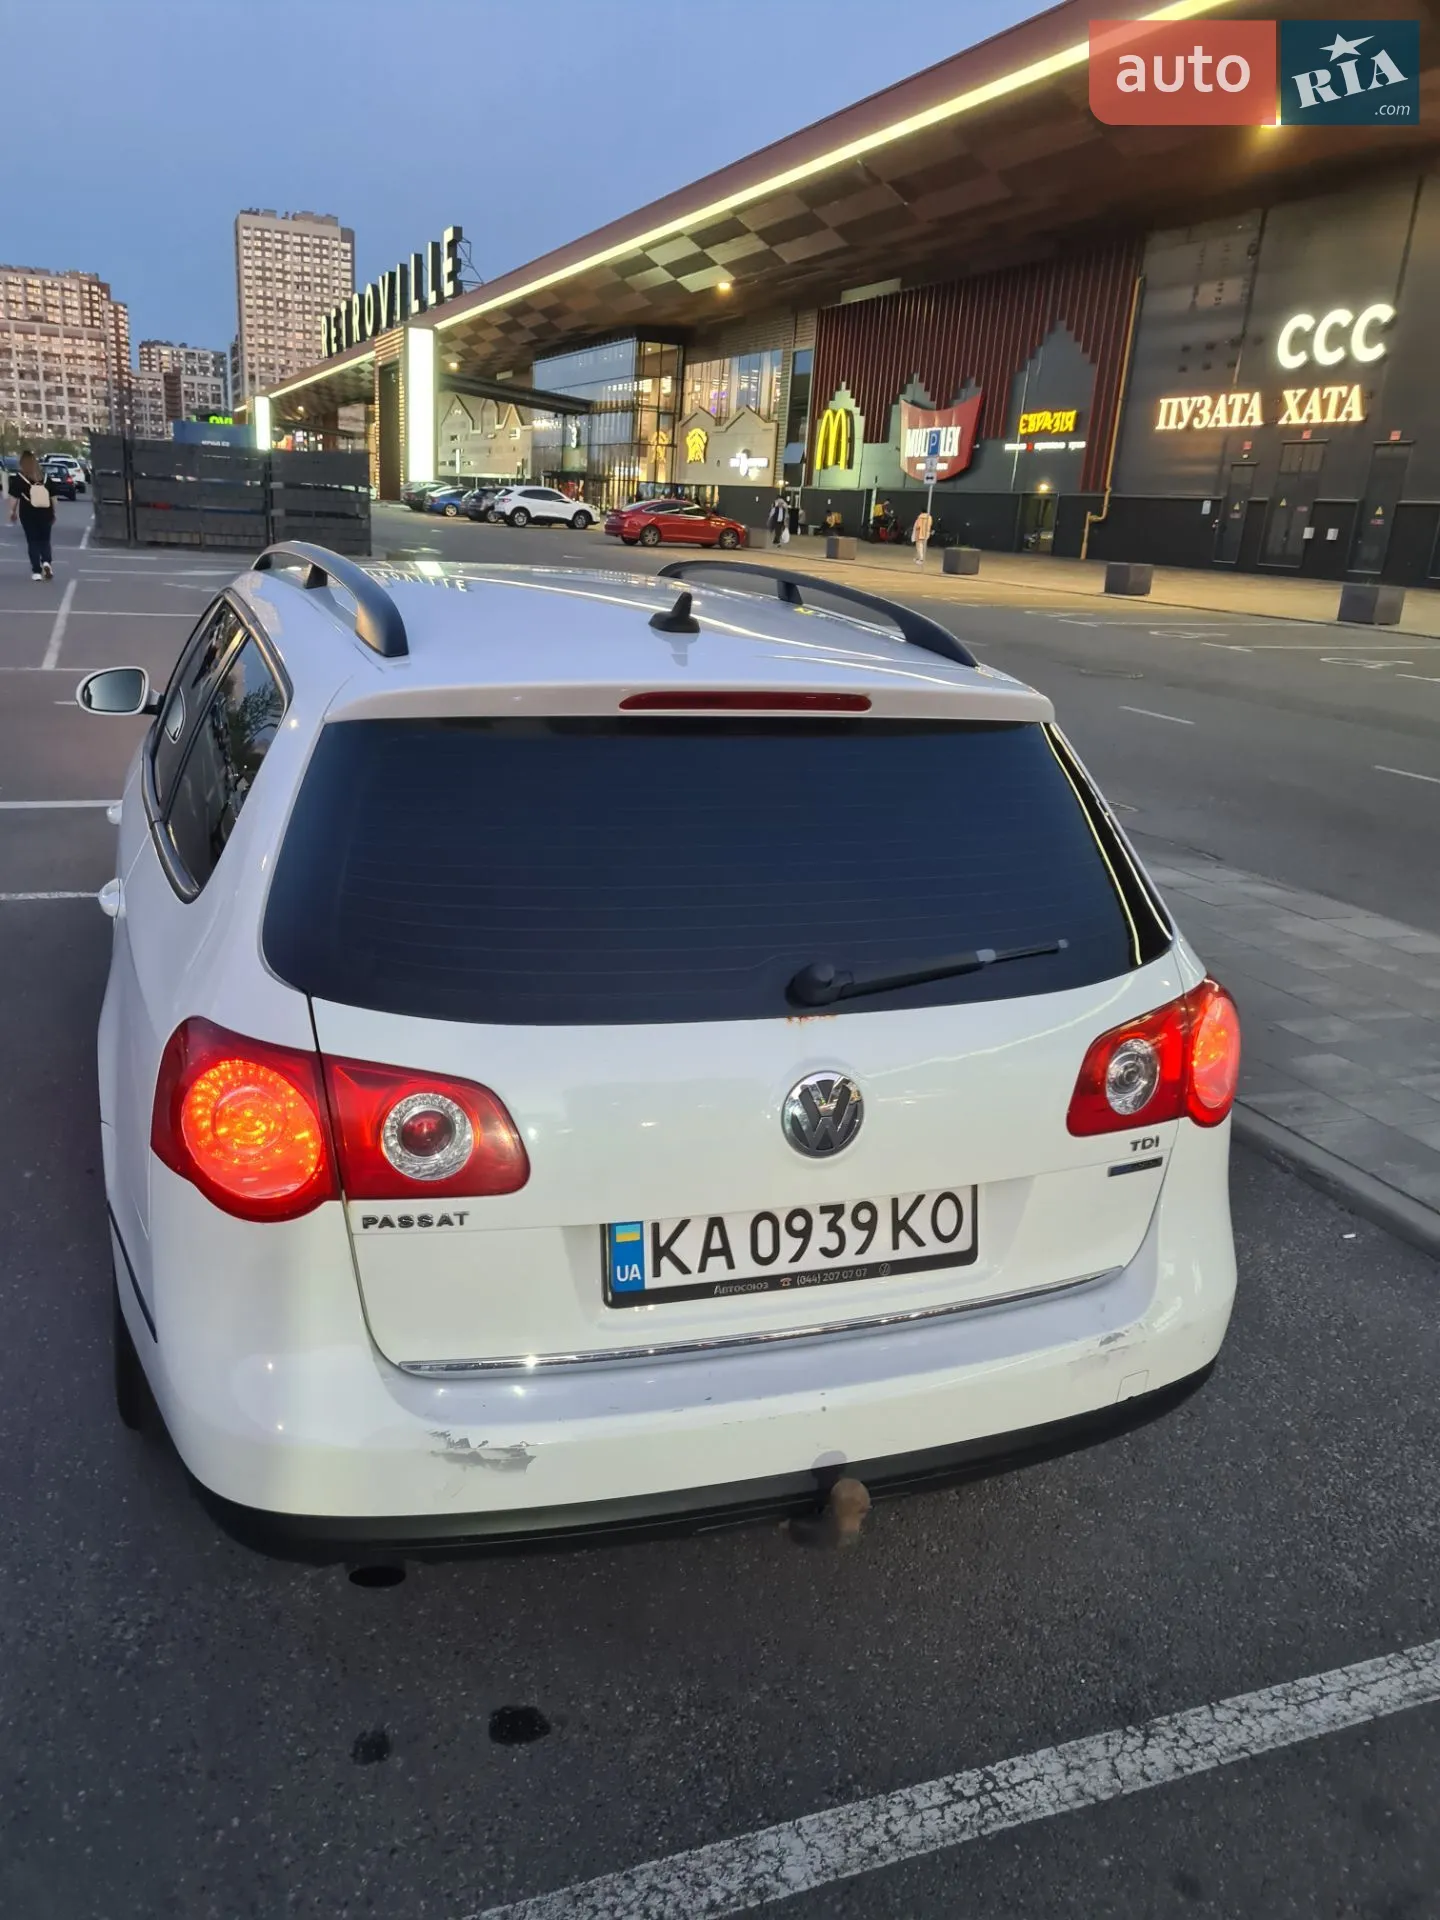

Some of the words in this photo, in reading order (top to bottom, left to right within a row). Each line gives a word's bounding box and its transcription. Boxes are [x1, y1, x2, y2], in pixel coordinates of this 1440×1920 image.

[321, 225, 463, 359] RETROVILLE
[1276, 303, 1397, 369] CCC
[1154, 391, 1265, 430] ПУЗАТА
[1277, 384, 1366, 425] ХАТА
[1129, 1135, 1160, 1152] TDI
[361, 1211, 470, 1229] PASSAT
[651, 1217, 736, 1278] KA
[749, 1201, 879, 1267] 0939
[891, 1191, 964, 1251] KO
[616, 1263, 642, 1283] UA
[822, 1271, 840, 1283] 207
